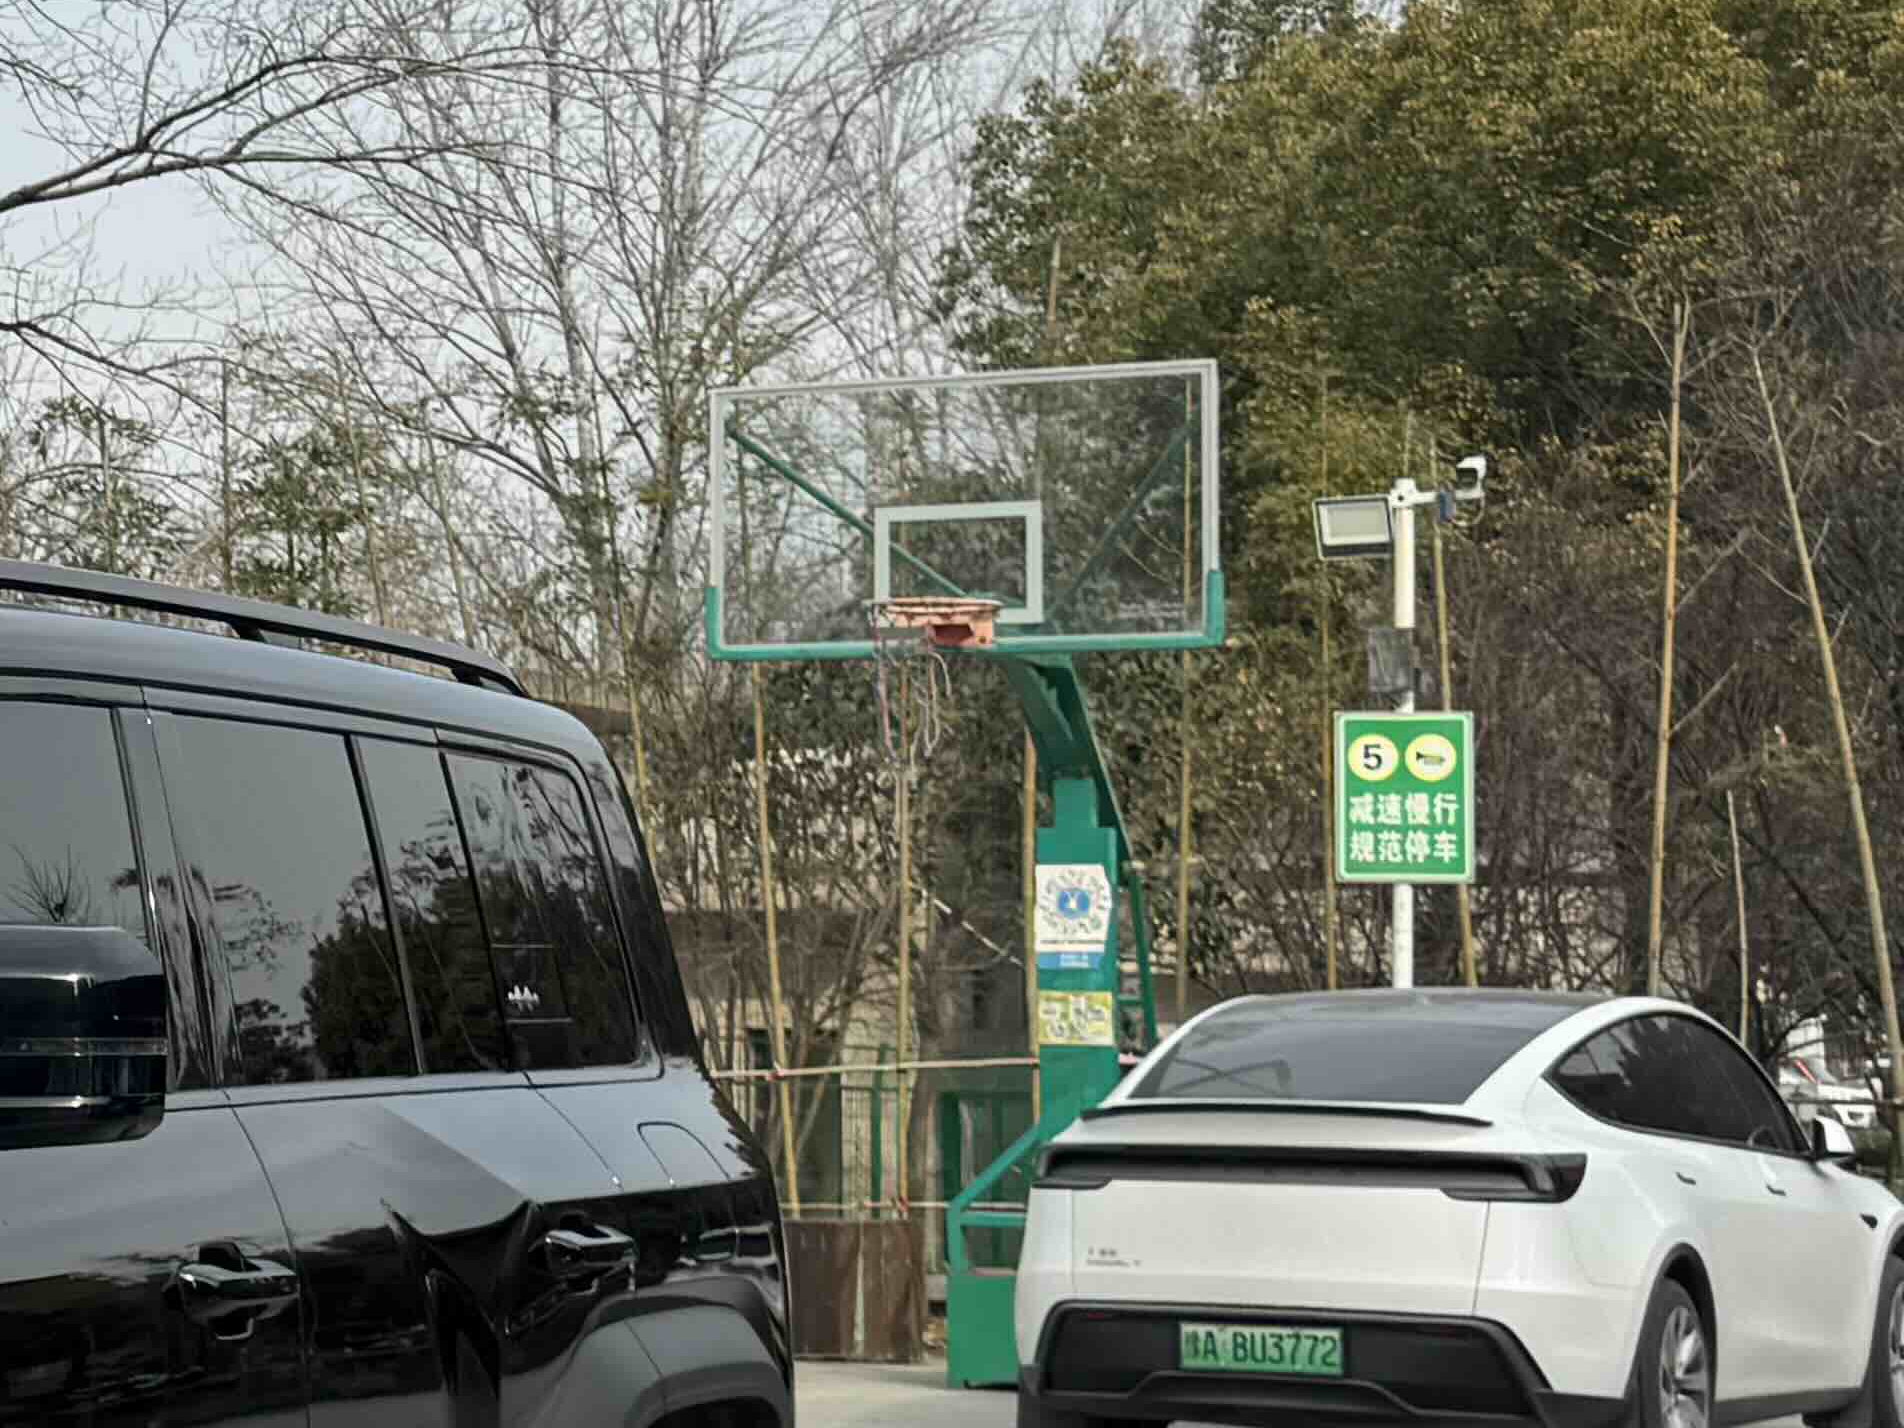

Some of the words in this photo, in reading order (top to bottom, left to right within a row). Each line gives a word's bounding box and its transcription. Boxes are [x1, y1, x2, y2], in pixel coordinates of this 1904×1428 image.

[1363, 744, 1382, 771] 5
[1349, 792, 1459, 825] 减速慢行
[1349, 829, 1459, 863] 规范停车
[1185, 1329, 1219, 1362] A
[1232, 1331, 1338, 1368] BU3772
